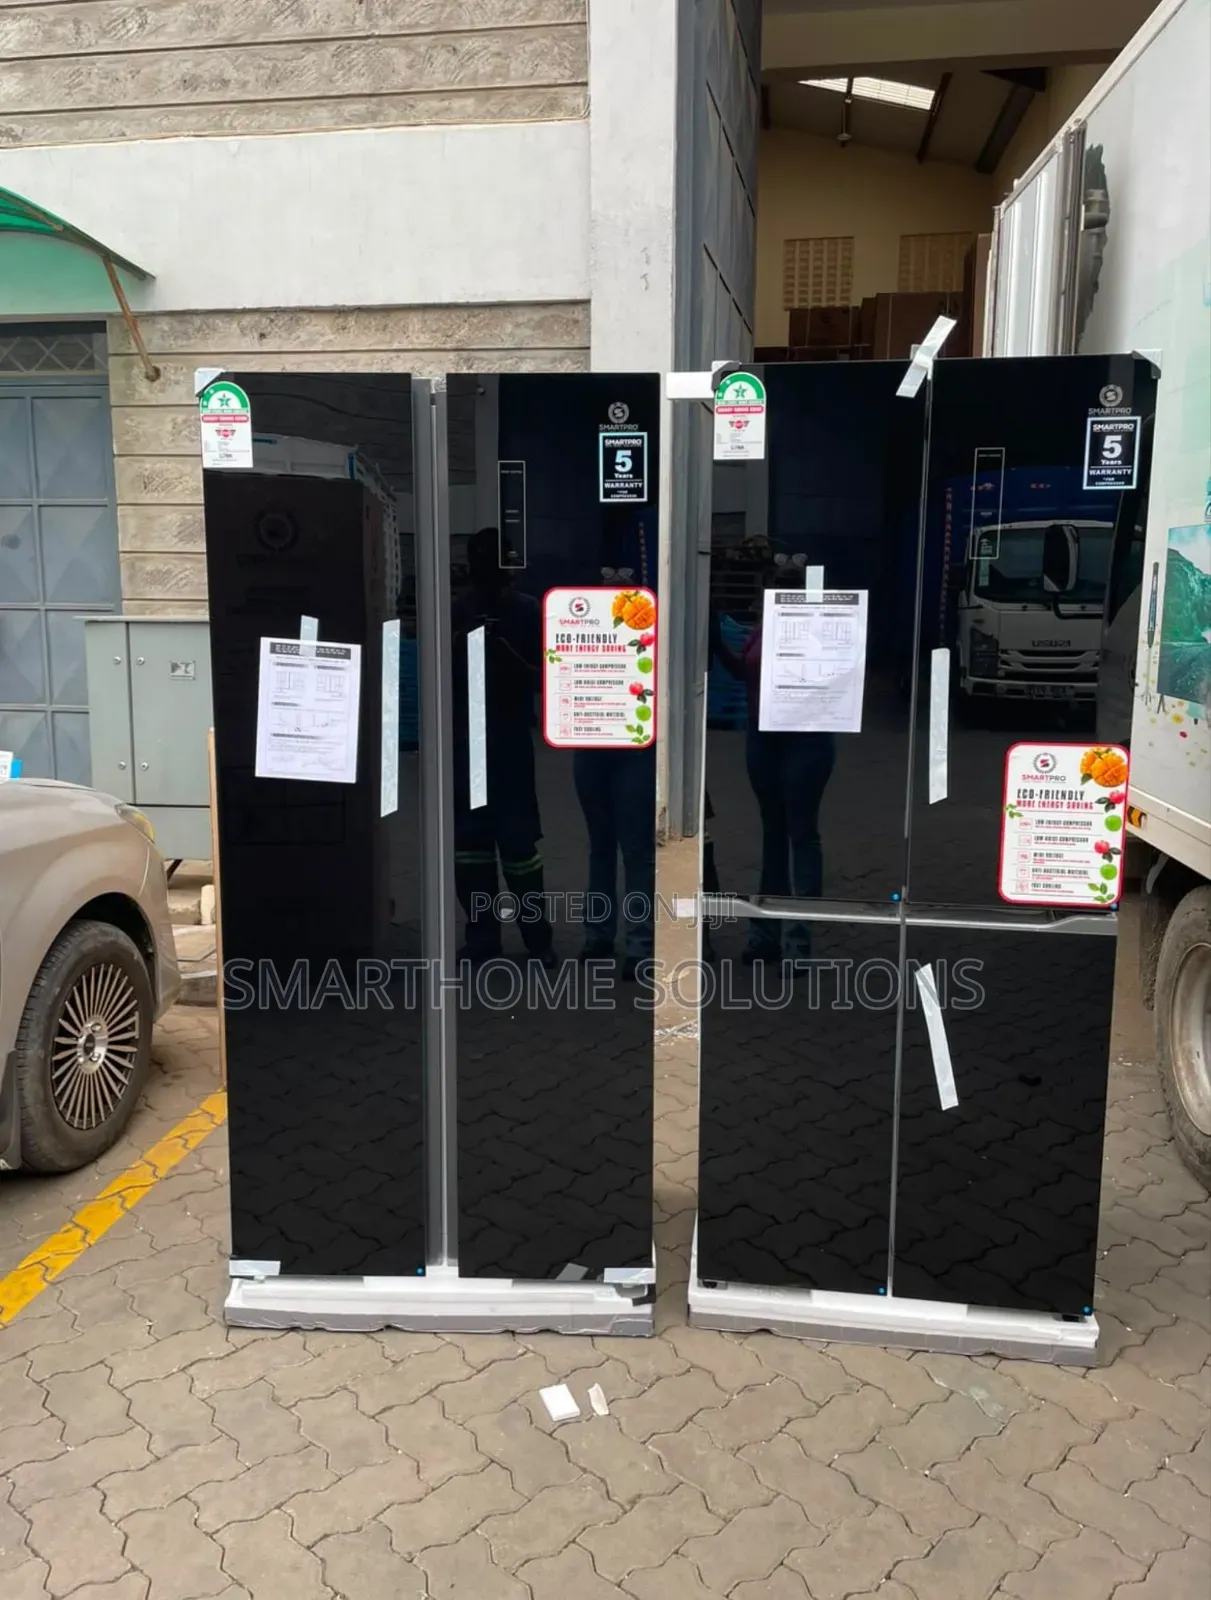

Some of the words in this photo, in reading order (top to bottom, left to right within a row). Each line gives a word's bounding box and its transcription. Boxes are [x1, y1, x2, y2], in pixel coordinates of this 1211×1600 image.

[1102, 435, 1122, 459] 5
[614, 450, 632, 472] 5
[556, 633, 617, 644] ECO-FRIENDLY
[1021, 774, 1066, 782] SMARTPRO
[1017, 788, 1085, 801] ECO-FRIENDLY
[1016, 800, 1035, 808] MORE
[1038, 801, 1063, 809] ENERGY
